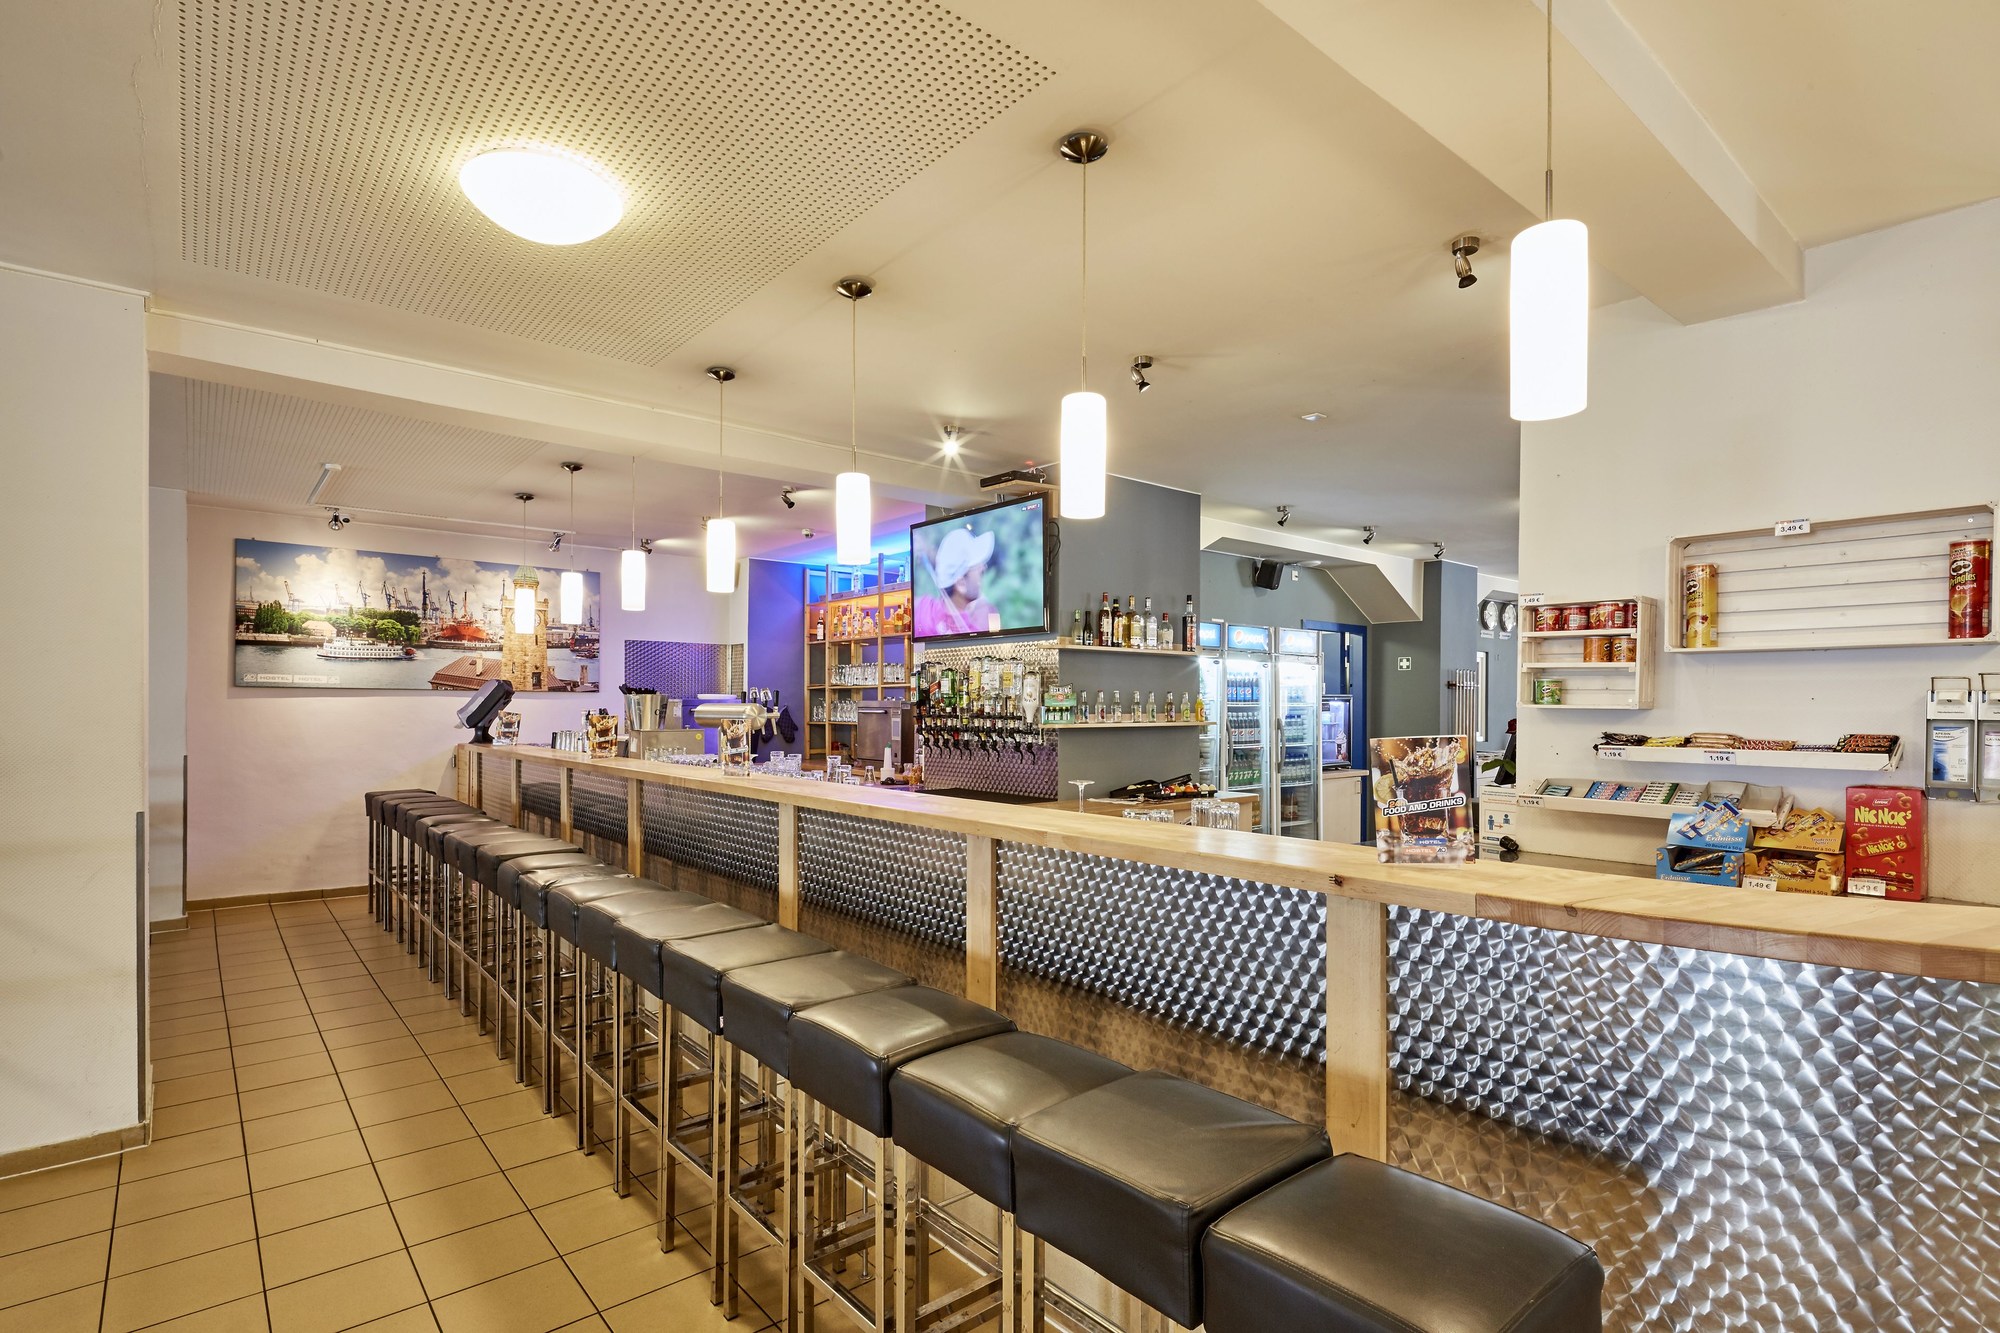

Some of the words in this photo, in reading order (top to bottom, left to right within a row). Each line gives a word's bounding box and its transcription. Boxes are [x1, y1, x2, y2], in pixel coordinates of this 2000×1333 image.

[1780, 525, 1797, 533] 3,49
[1949, 573, 1977, 589] Pringles
[1384, 806, 1407, 816] FOOD
[1408, 803, 1428, 812] AND
[1429, 797, 1463, 809] DRINKS
[1705, 834, 1744, 843] Erdnüsse
[1748, 881, 1764, 889] 1,49
[1853, 883, 1871, 891] 1,49
[1794, 887, 1812, 895] Beutel
